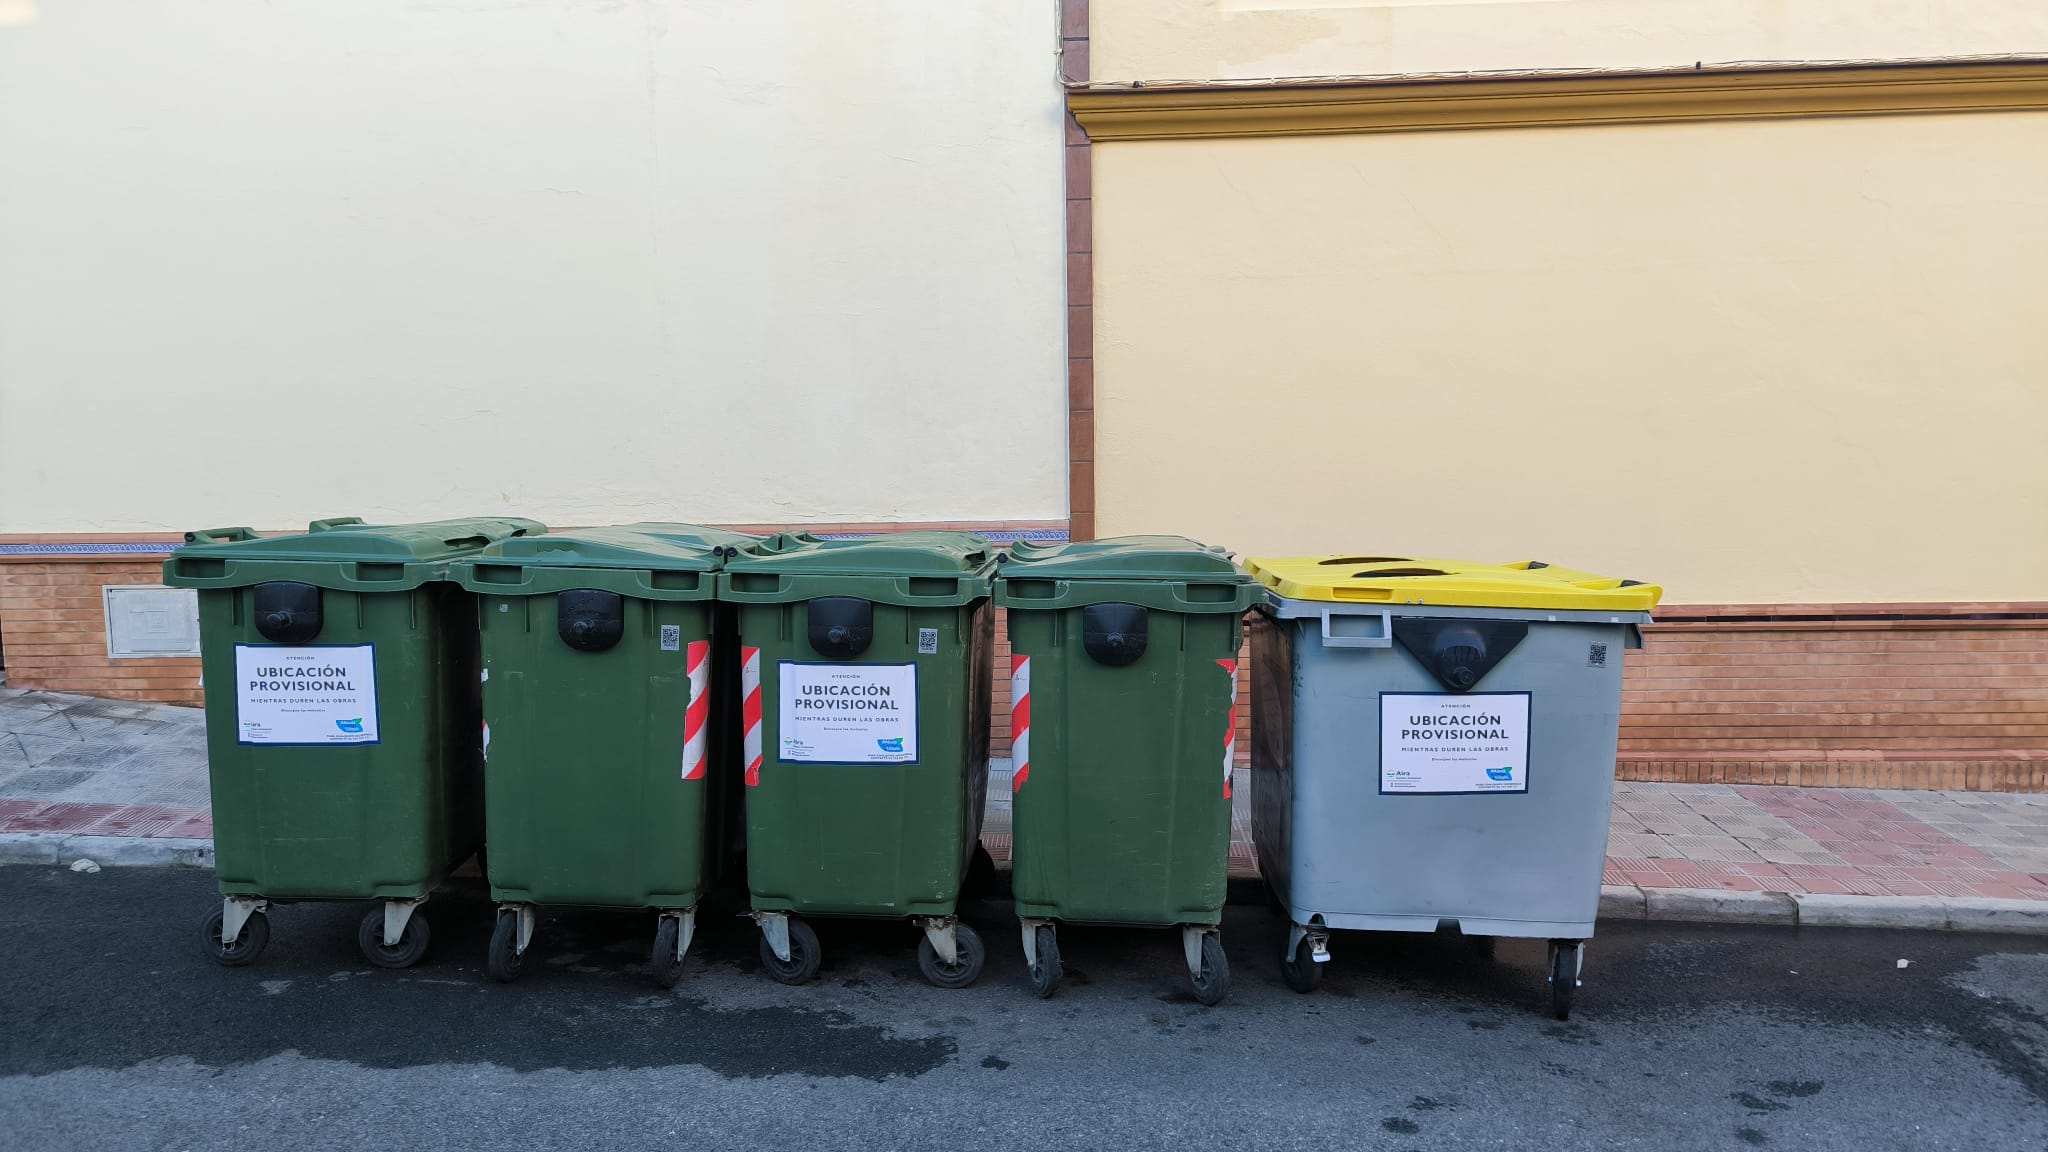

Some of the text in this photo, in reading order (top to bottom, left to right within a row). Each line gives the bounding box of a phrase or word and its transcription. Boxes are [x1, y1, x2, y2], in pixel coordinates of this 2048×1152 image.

[257, 664, 346, 677] UBICACIÓN
[250, 681, 356, 691] PROVISIONAL
[802, 683, 890, 696] UBICACIÓN
[795, 699, 899, 710] PROVISIONAL
[1410, 712, 1501, 725] UBICACIÓN
[1402, 729, 1509, 739] PROVISIONAL
